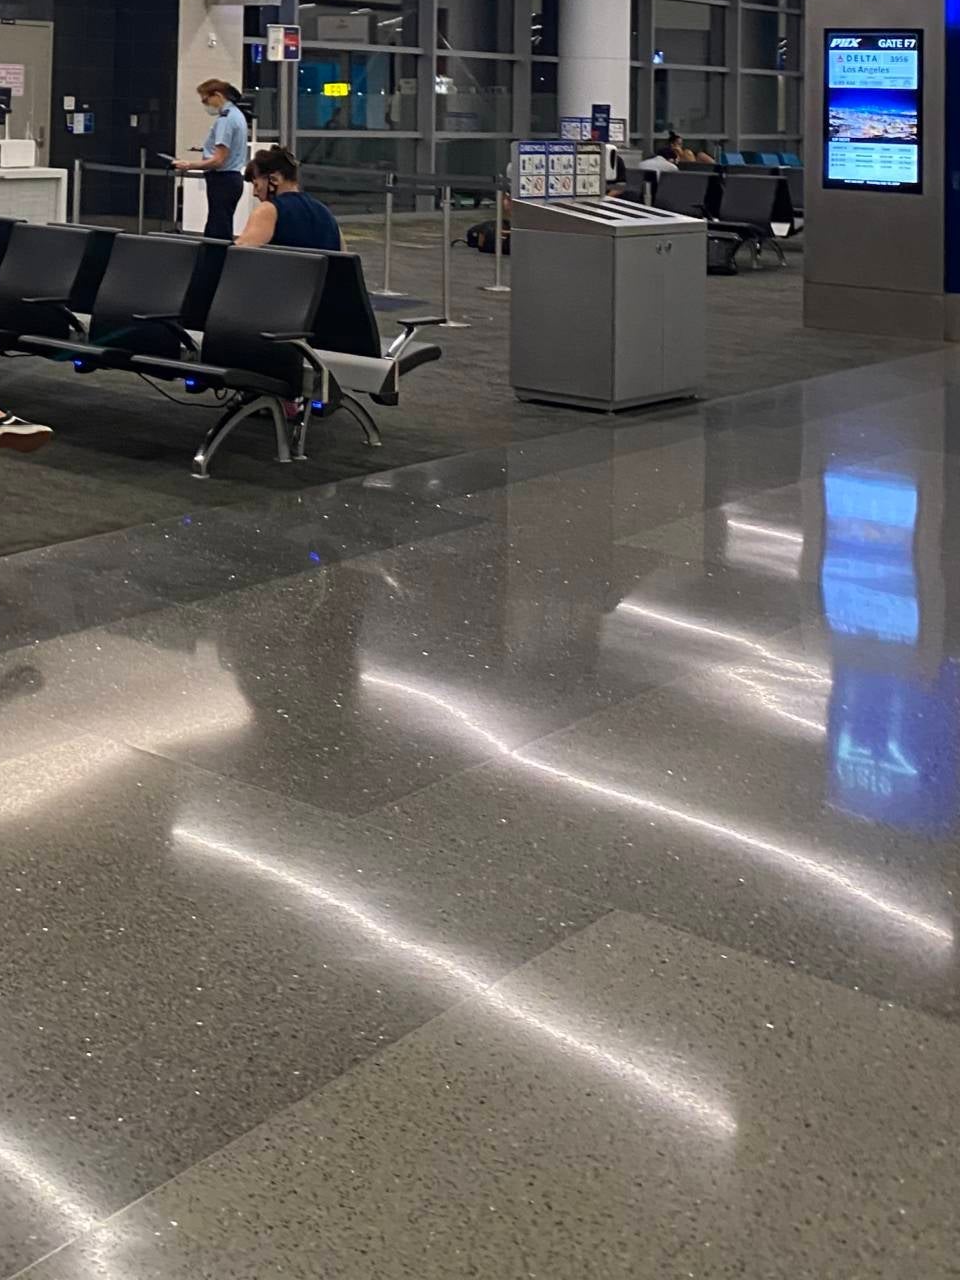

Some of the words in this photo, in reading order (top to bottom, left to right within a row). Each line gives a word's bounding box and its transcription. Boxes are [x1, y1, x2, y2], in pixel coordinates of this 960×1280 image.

[878, 39, 903, 48] GATE
[904, 39, 917, 48] F7
[846, 55, 878, 63] DELTA
[842, 65, 856, 73] Los
[858, 65, 890, 75] Angeles
